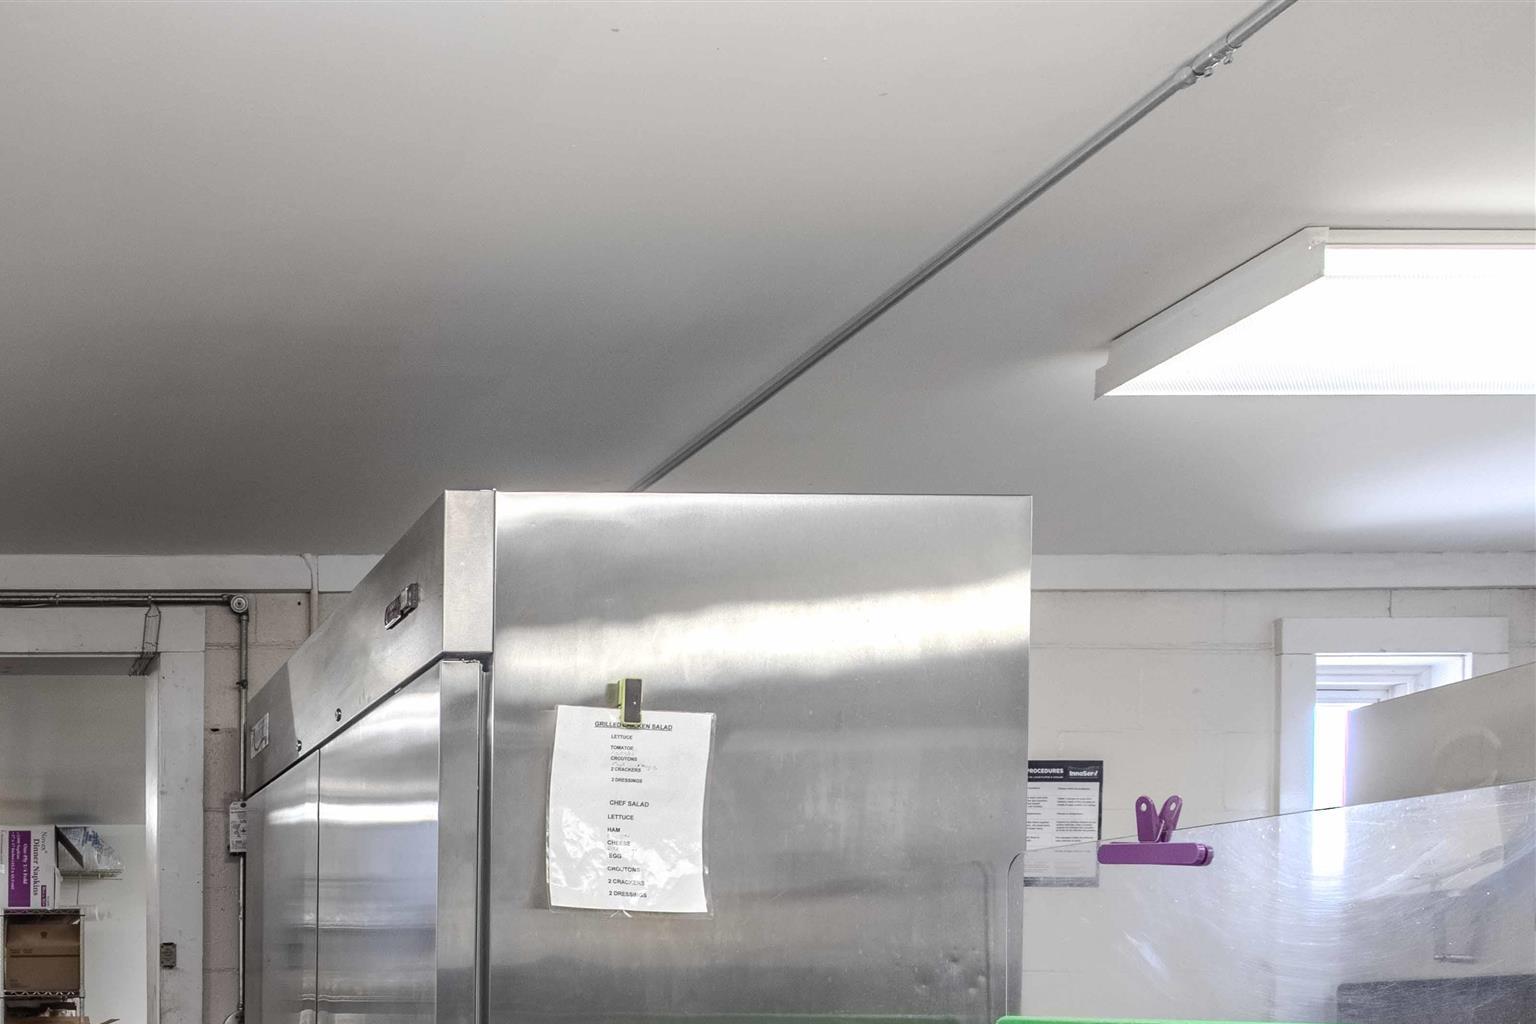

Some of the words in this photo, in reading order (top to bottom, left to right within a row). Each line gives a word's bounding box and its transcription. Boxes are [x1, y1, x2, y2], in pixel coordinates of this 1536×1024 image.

[594, 720, 621, 728] GRILLED
[652, 723, 672, 731] SALAD
[32, 866, 40, 895] Napkins
